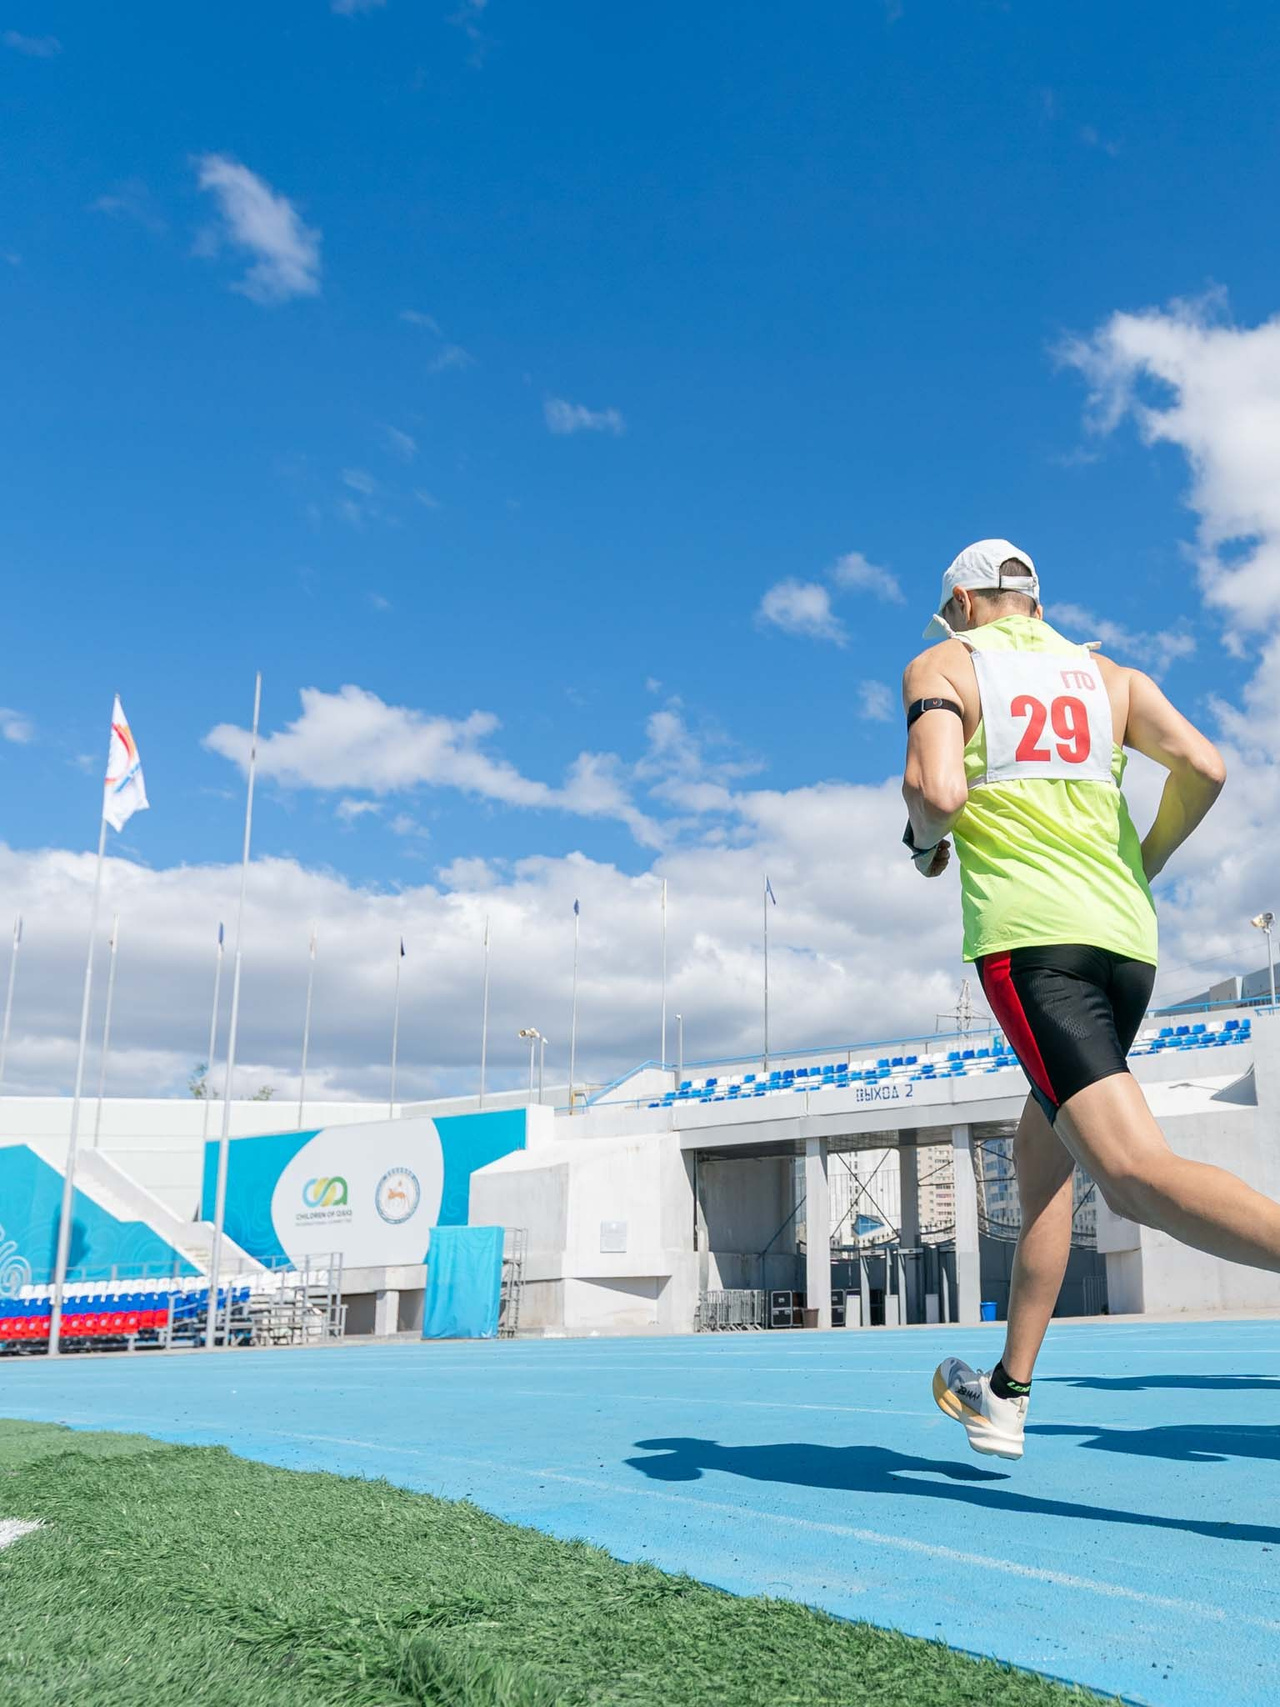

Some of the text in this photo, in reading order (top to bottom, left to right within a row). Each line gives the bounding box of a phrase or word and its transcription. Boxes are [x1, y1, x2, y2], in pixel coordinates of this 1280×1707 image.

[1060, 669, 1096, 691] ГТО
[1010, 694, 1092, 764] 29
[856, 1083, 913, 1102] ВЫХОД 2
